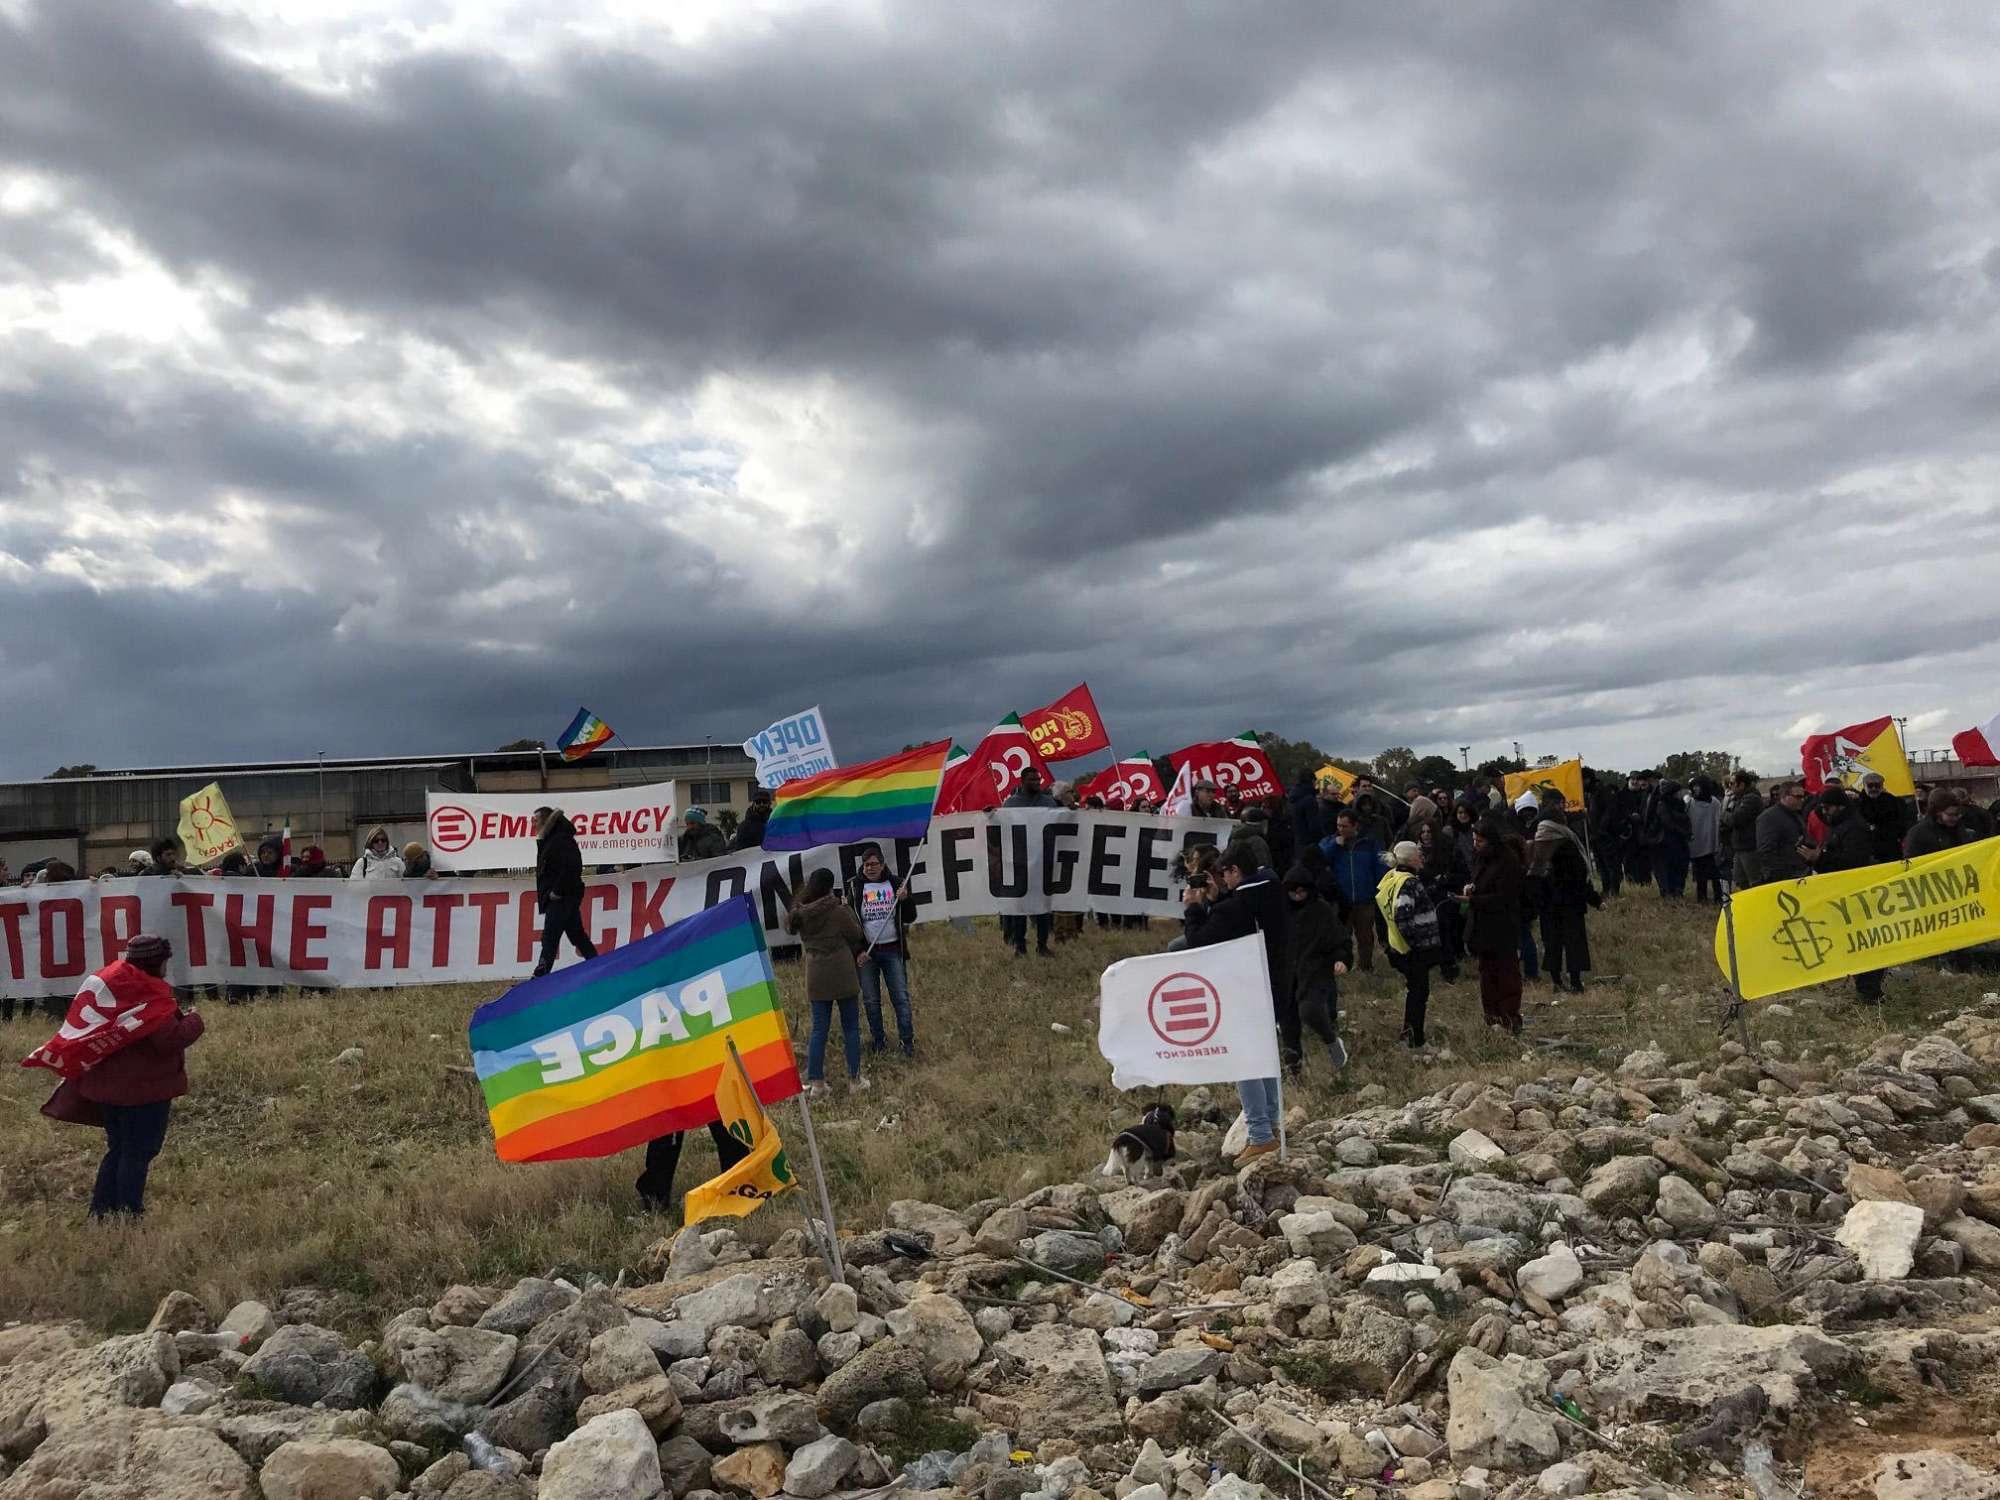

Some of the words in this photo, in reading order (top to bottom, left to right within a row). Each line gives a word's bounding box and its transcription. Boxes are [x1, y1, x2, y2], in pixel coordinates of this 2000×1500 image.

[480, 805, 670, 840] EMGENCY
[0, 895, 142, 979] TOP
[171, 892, 332, 971] THE
[364, 877, 676, 970] ATTACK
